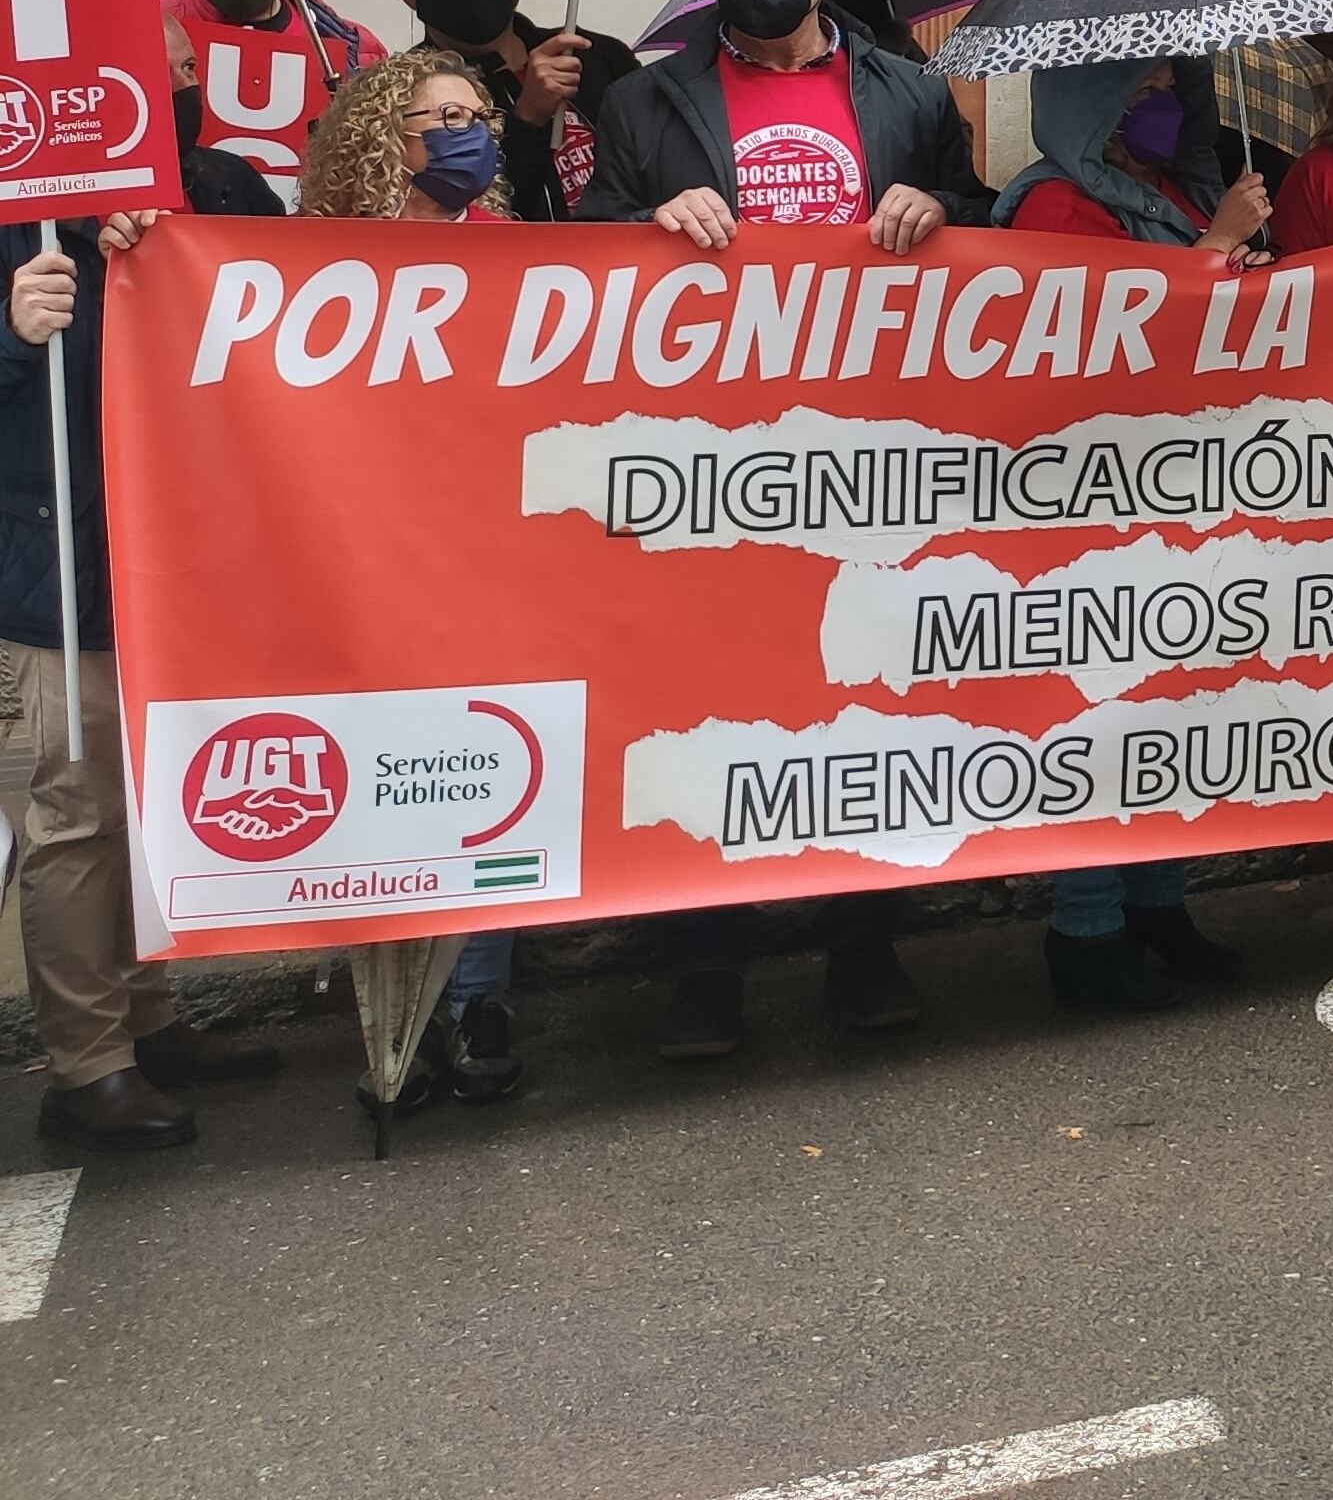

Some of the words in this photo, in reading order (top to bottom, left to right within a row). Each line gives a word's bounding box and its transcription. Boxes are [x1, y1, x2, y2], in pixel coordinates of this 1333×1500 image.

[50, 86, 106, 116] FSP
[54, 119, 102, 133] Servicios
[769, 126, 811, 139] MENOS
[811, 132, 858, 184] BUROCRACIA
[16, 175, 97, 196] Andalucía
[736, 161, 838, 186] DOCENTES
[737, 184, 837, 208] ESENCIALES
[189, 260, 470, 388] POR
[495, 257, 1170, 389] DIGNIFICAR
[1192, 264, 1317, 376] LA
[911, 577, 1270, 678] MENOS
[202, 734, 329, 797] UGT
[375, 748, 500, 779] Servicios
[374, 779, 492, 808] Públicos
[723, 734, 1094, 848] MENOS
[287, 866, 440, 903] Andalucía
